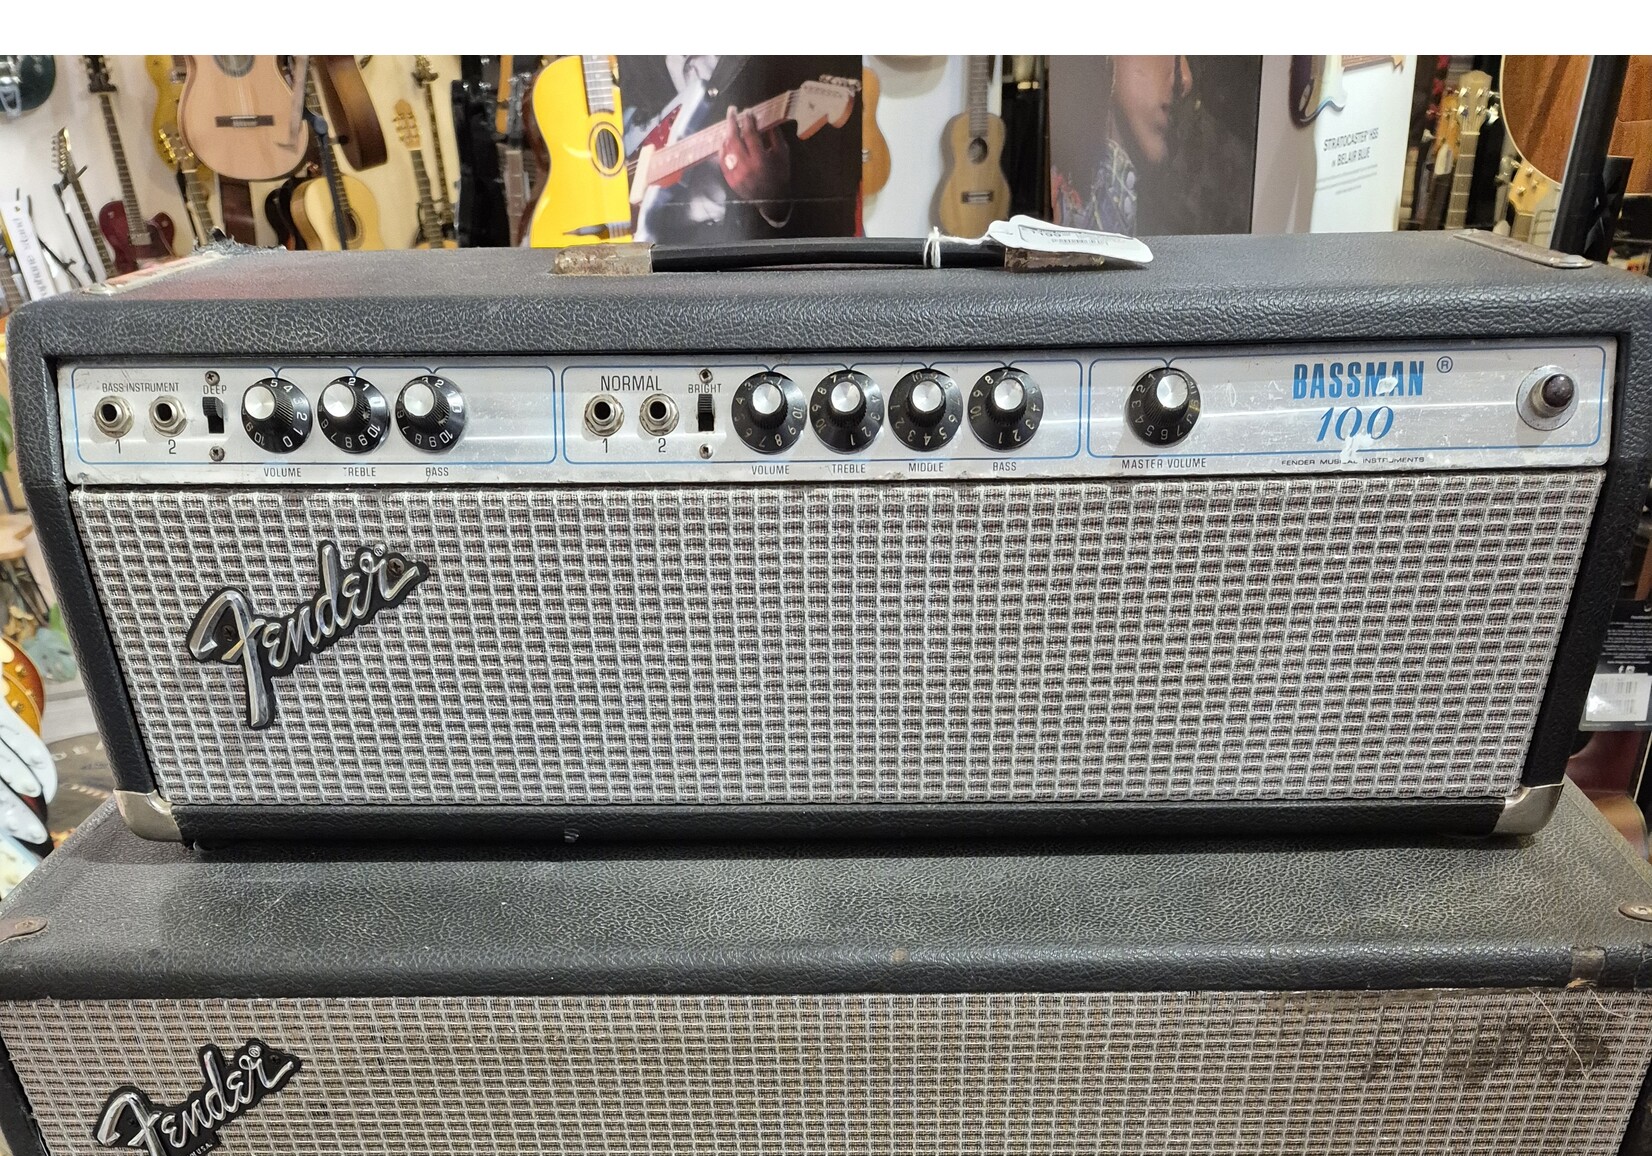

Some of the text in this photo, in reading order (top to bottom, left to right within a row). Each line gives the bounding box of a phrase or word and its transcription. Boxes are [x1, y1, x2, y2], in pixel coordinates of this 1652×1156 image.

[911, 372, 923, 382] 10
[984, 375, 994, 385] 8
[1148, 373, 1156, 381] 1
[1292, 360, 1424, 400] BASSMAN
[102, 382, 180, 392] BASS INSTRUMENT
[203, 384, 226, 394] DEEP
[435, 379, 444, 388] 2
[600, 376, 662, 391] NORMAL
[688, 384, 722, 394] BRIGHT
[1136, 384, 1146, 394] 2
[348, 378, 356, 386] 2
[367, 424, 381, 438] 10
[817, 387, 827, 395] 8
[830, 374, 837, 383] 7
[862, 427, 871, 437] 2
[1132, 400, 1142, 408] 3
[297, 412, 307, 421] 2
[792, 407, 804, 419] 10
[970, 405, 982, 419] 10
[1025, 419, 1034, 430] 3
[1135, 415, 1144, 423] 4
[1316, 406, 1394, 442] 100
[293, 427, 303, 436] 1
[907, 430, 916, 442] 3
[939, 427, 948, 440] 5
[1013, 429, 1021, 442] 2
[1145, 425, 1155, 437] 5
[439, 430, 453, 444] 10
[775, 434, 782, 446] 8
[924, 433, 932, 446] 4
[115, 440, 176, 454] 1 2
[602, 438, 666, 453] 1 2
[832, 464, 866, 473] TREBLE
[908, 462, 943, 472] MIDDLE
[993, 462, 1017, 471] BASS
[1122, 458, 1206, 469] MASTER VOLUME
[264, 468, 302, 477] VOLUME
[426, 467, 449, 477] BASS
[752, 465, 790, 475] VOLUME
[189, 543, 420, 728] Fender
